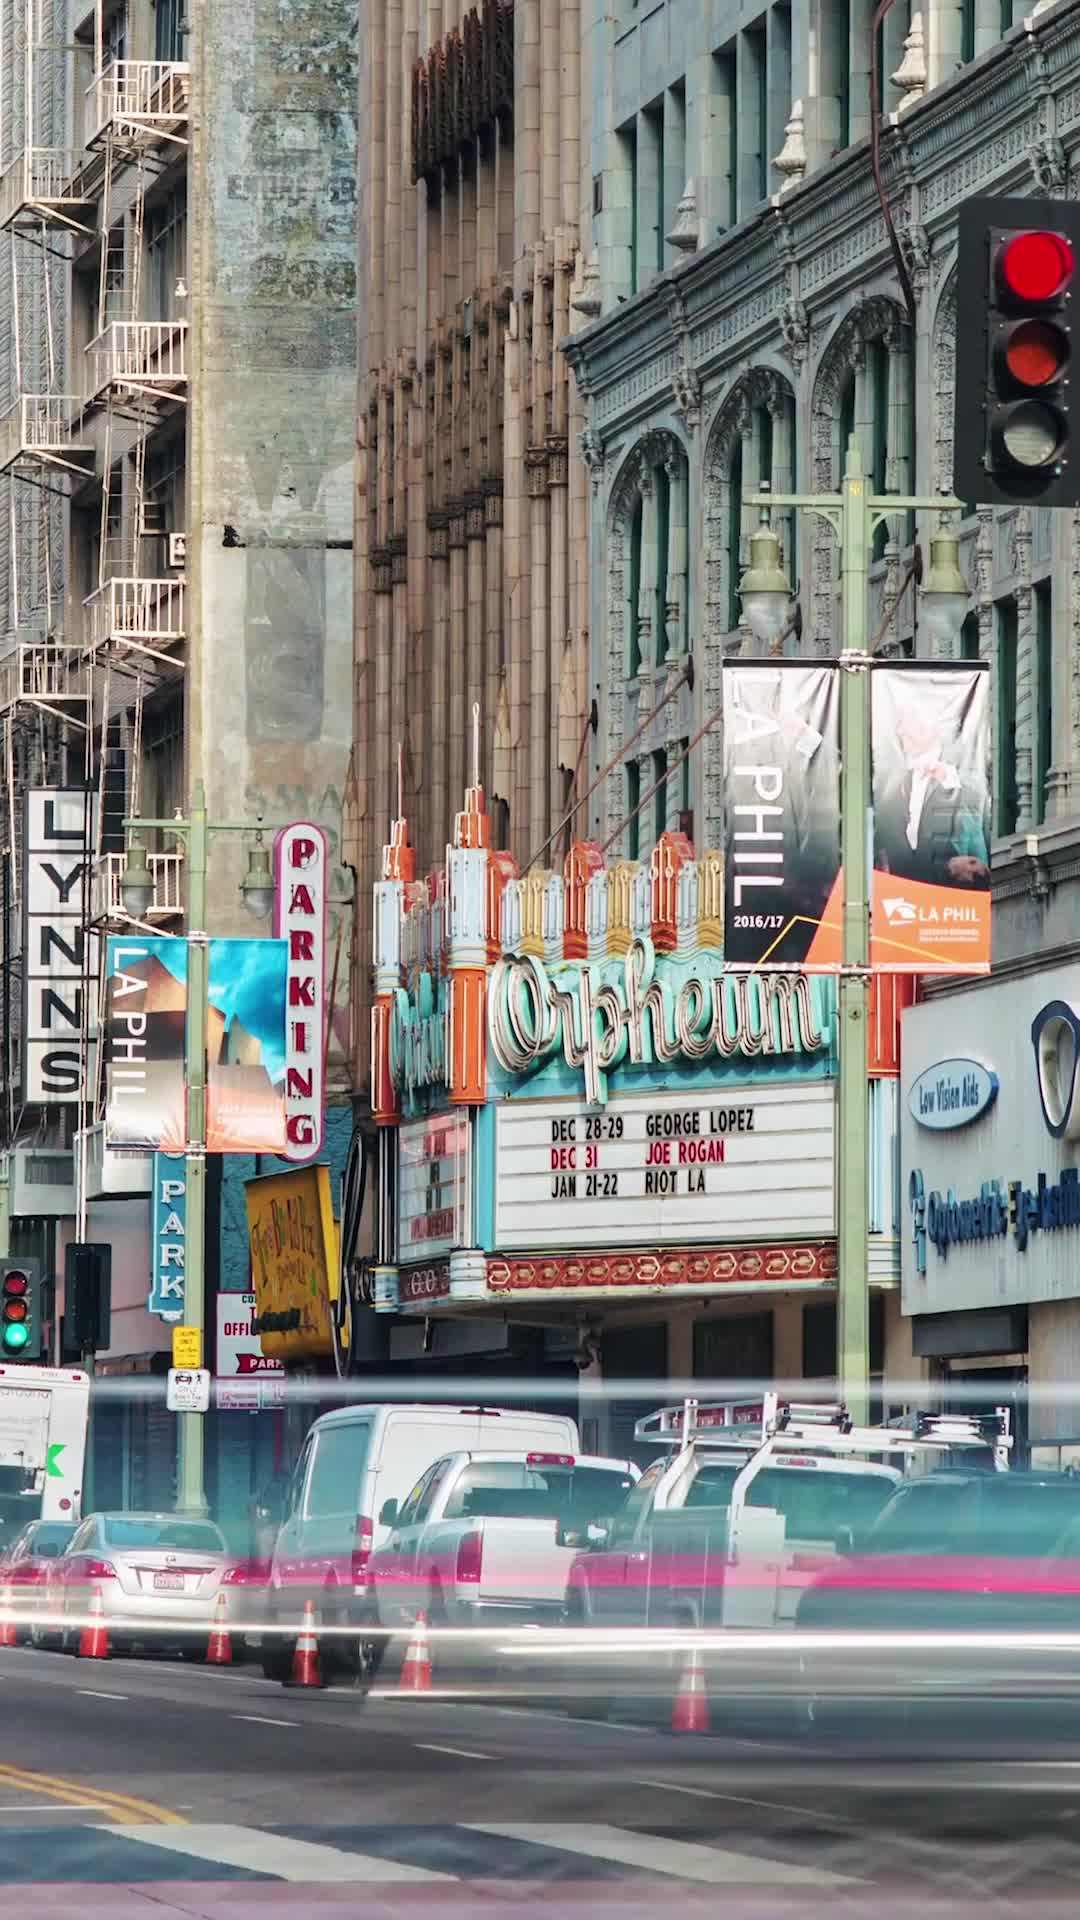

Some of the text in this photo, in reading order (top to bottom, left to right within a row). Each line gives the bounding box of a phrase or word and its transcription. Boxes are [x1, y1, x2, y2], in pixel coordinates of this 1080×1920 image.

[733, 765, 784, 907] PHIL
[39, 799, 88, 1094] LYNNS
[733, 915, 785, 928] 2016/17
[919, 905, 980, 923] LA PHIL
[111, 946, 149, 1105] LA PHIL
[286, 837, 316, 1145] PARKING
[488, 936, 832, 1106] Orpheum
[551, 1108, 754, 1142] DEC 28-29 GEORGE LOPEZ
[919, 1071, 979, 1115] Low Vision Aids
[551, 1139, 725, 1170] DEC 31 JOE ROGAN
[551, 1169, 706, 1198] JAN 21-22 RIOT LA
[160, 1179, 187, 1300] PARK
